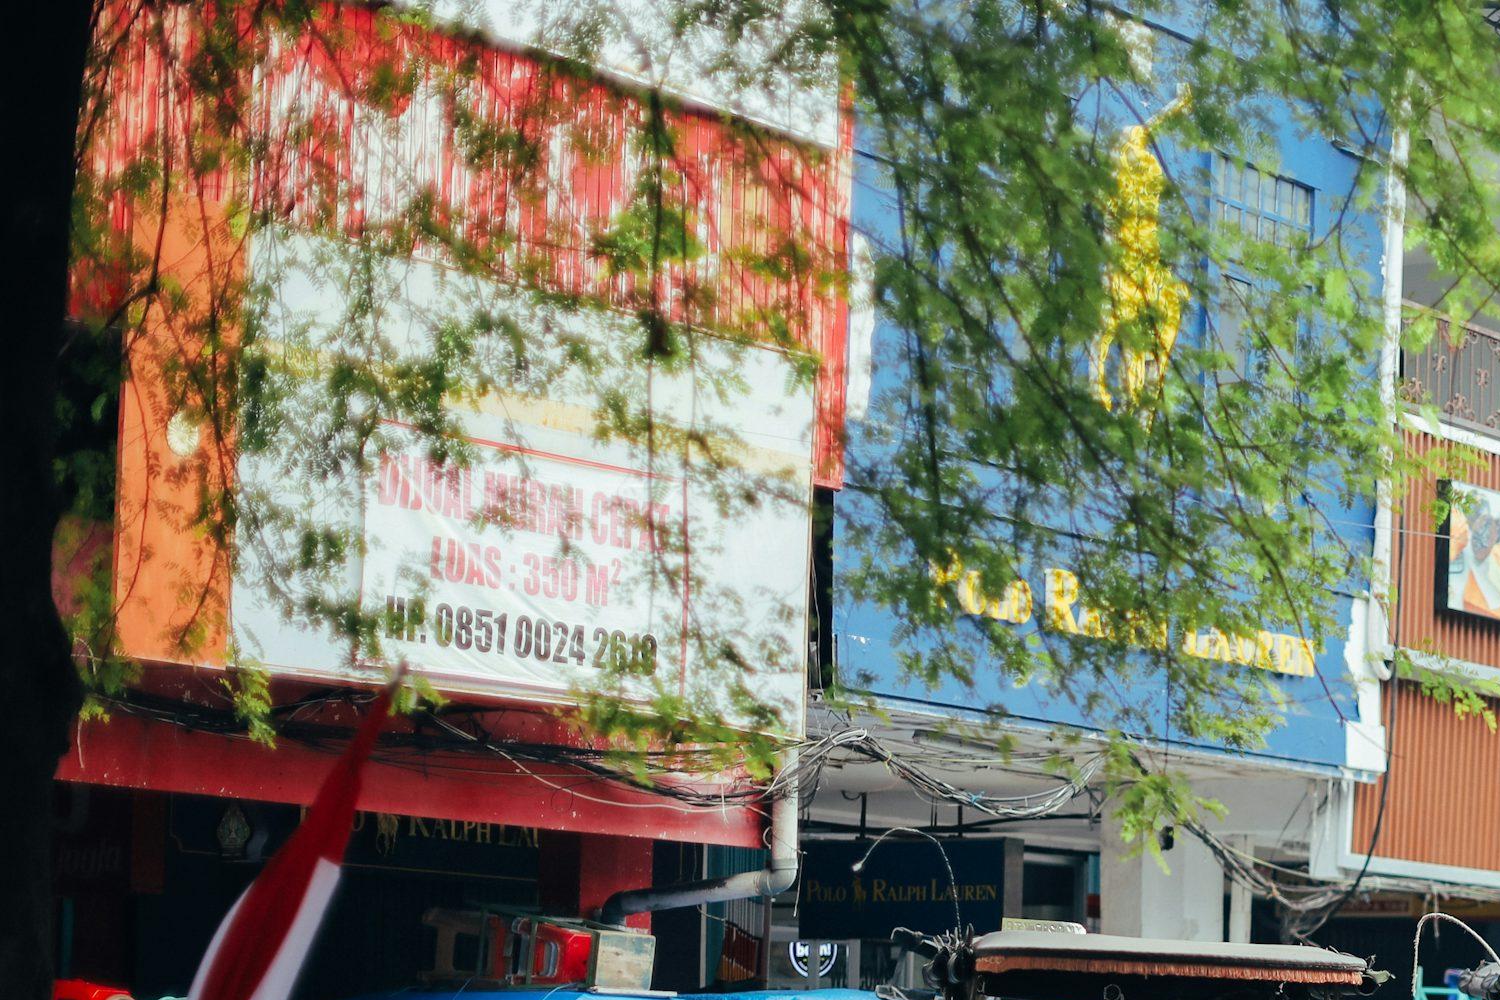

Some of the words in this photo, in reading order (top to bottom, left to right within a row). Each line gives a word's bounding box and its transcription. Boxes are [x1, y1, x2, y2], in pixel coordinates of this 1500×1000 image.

[378, 453, 474, 520] DIJUAL
[591, 492, 670, 552] CEPAT
[430, 536, 502, 590] LUAS
[522, 553, 579, 602] 350
[435, 603, 508, 655] 0851
[514, 615, 586, 667] 0024
[806, 880, 847, 903] POLO
[872, 879, 928, 903] RALPH
[931, 878, 998, 903] LAUREN
